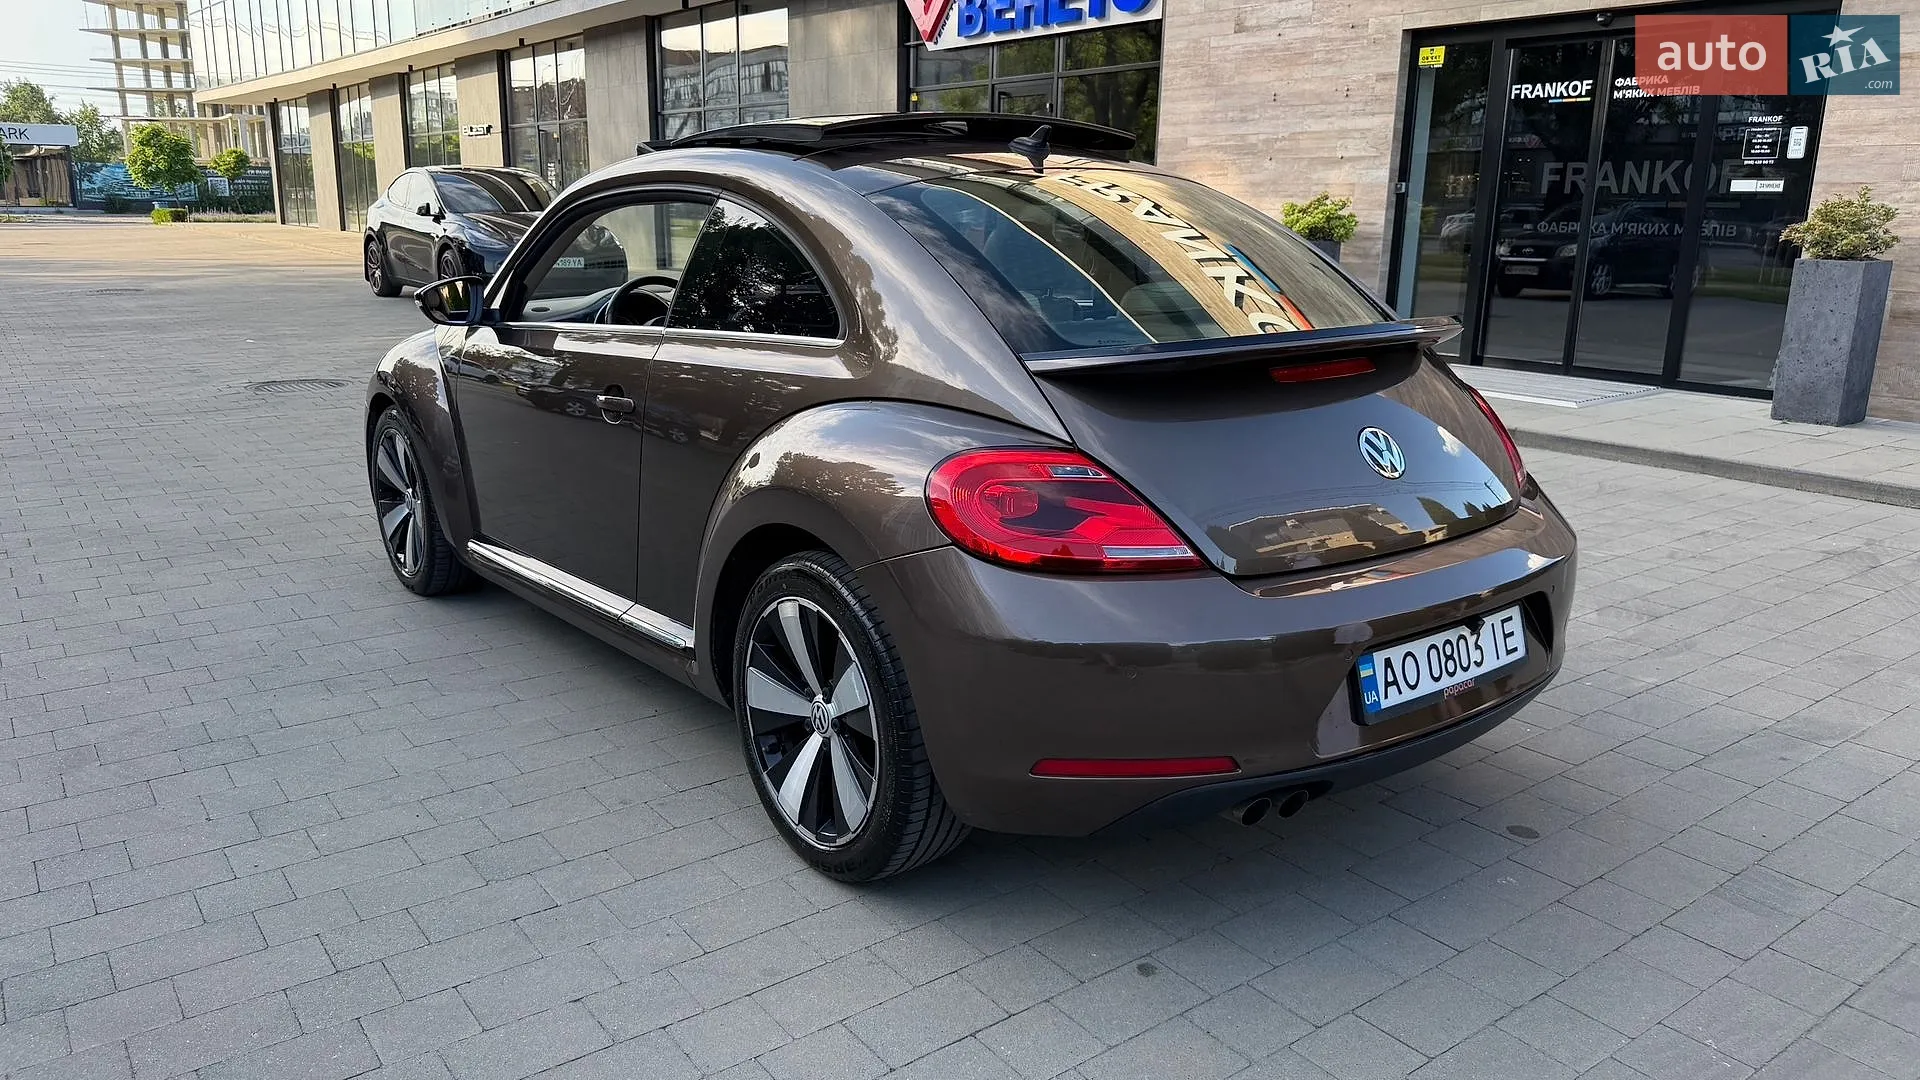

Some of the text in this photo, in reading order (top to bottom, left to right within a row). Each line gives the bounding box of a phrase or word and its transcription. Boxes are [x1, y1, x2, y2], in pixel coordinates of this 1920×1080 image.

[957, 0, 1153, 37] ВЕН
[1511, 80, 1593, 99] FRANKOF
[1614, 75, 1669, 87] ФАБРИКА
[1613, 85, 1700, 99] М'ЯКИХ МЕБЛІВ
[1748, 115, 1783, 123] FRANKOF
[1540, 160, 1745, 194] FRANKOF
[1673, 220, 1737, 237] МБЛІВ
[1383, 615, 1519, 700] AO 0803 IE
[1364, 690, 1379, 704] UA
